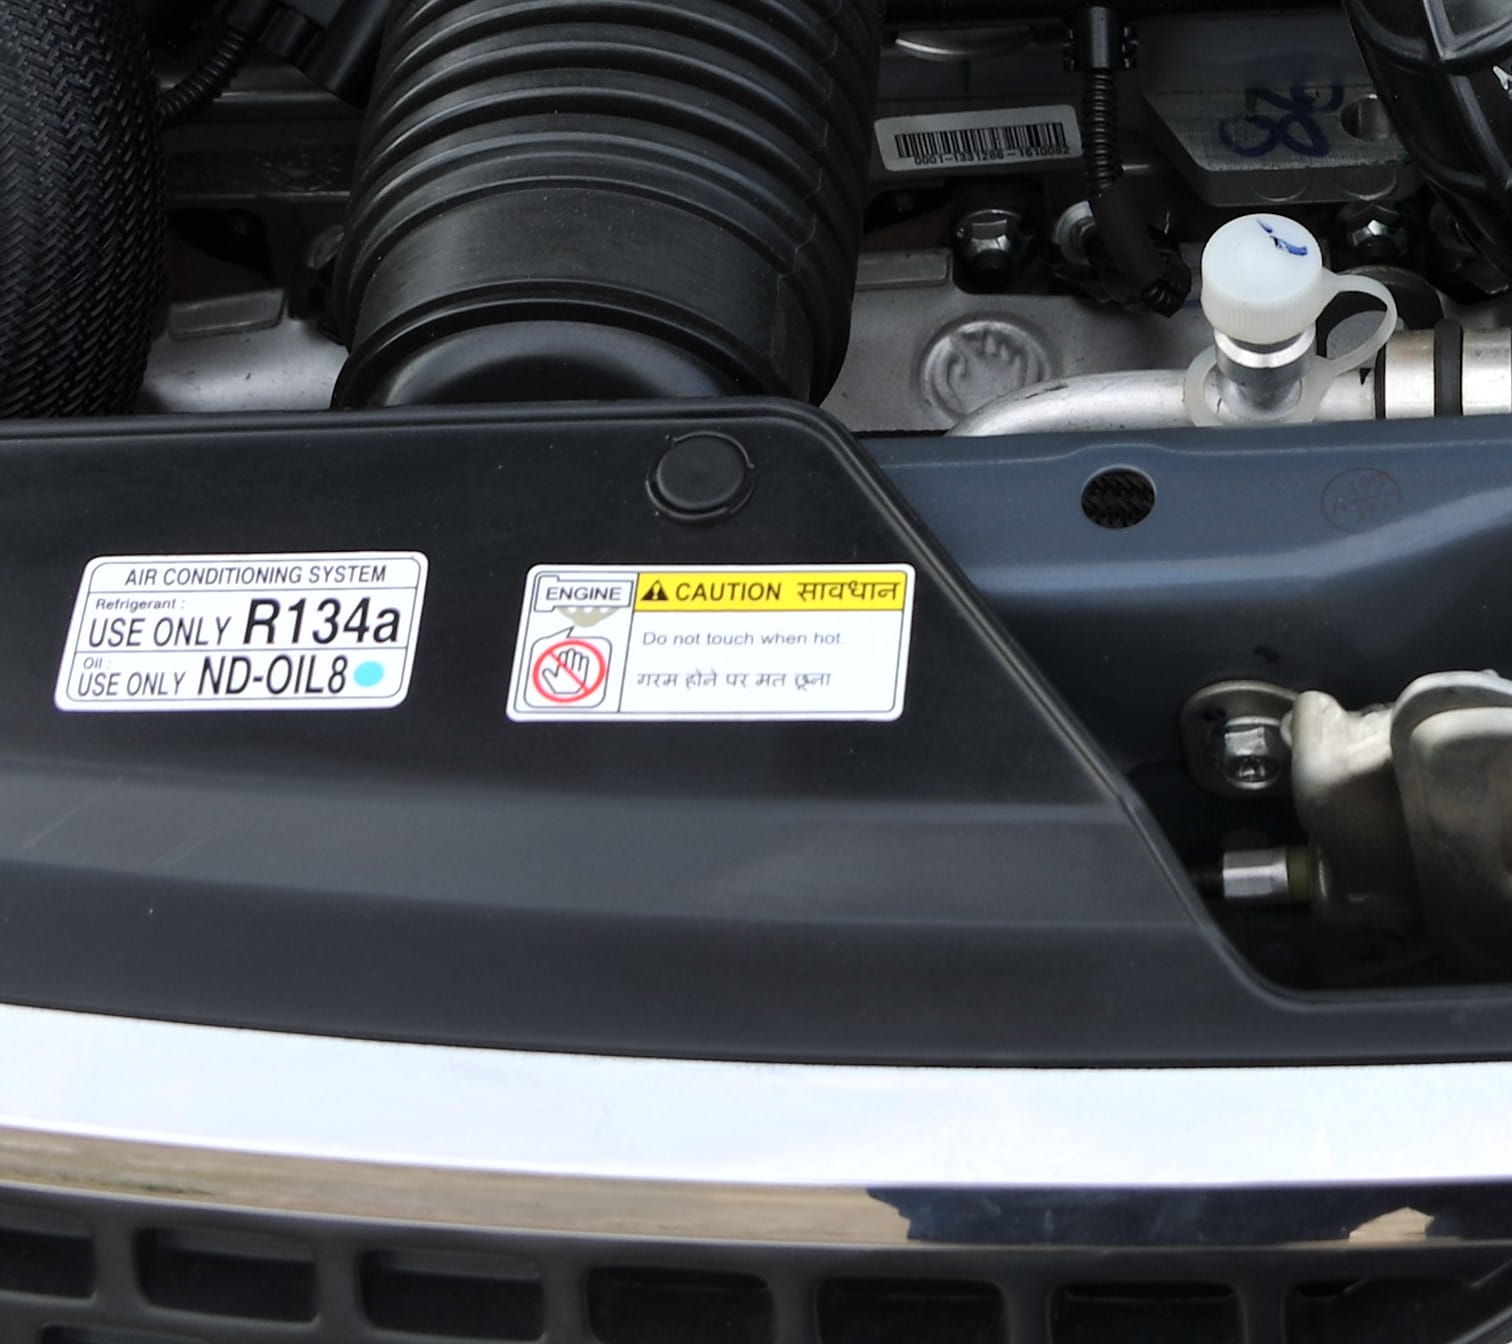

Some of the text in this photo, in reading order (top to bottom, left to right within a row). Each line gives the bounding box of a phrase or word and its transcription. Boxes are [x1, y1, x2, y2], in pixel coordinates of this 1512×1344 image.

[124, 564, 386, 585] AIR CONDITIONING SYSTEM
[545, 587, 619, 600] ENGINE
[675, 580, 900, 601] CAUTION सावधान
[95, 598, 177, 613] Refrigerant
[88, 597, 400, 647] USE ONLY R134a
[642, 631, 667, 645] Do
[673, 633, 700, 644] not
[706, 632, 753, 644] touch
[760, 632, 806, 644] when
[83, 656, 103, 669] Oil
[77, 654, 347, 696] USE ONLY ND-OIL8
